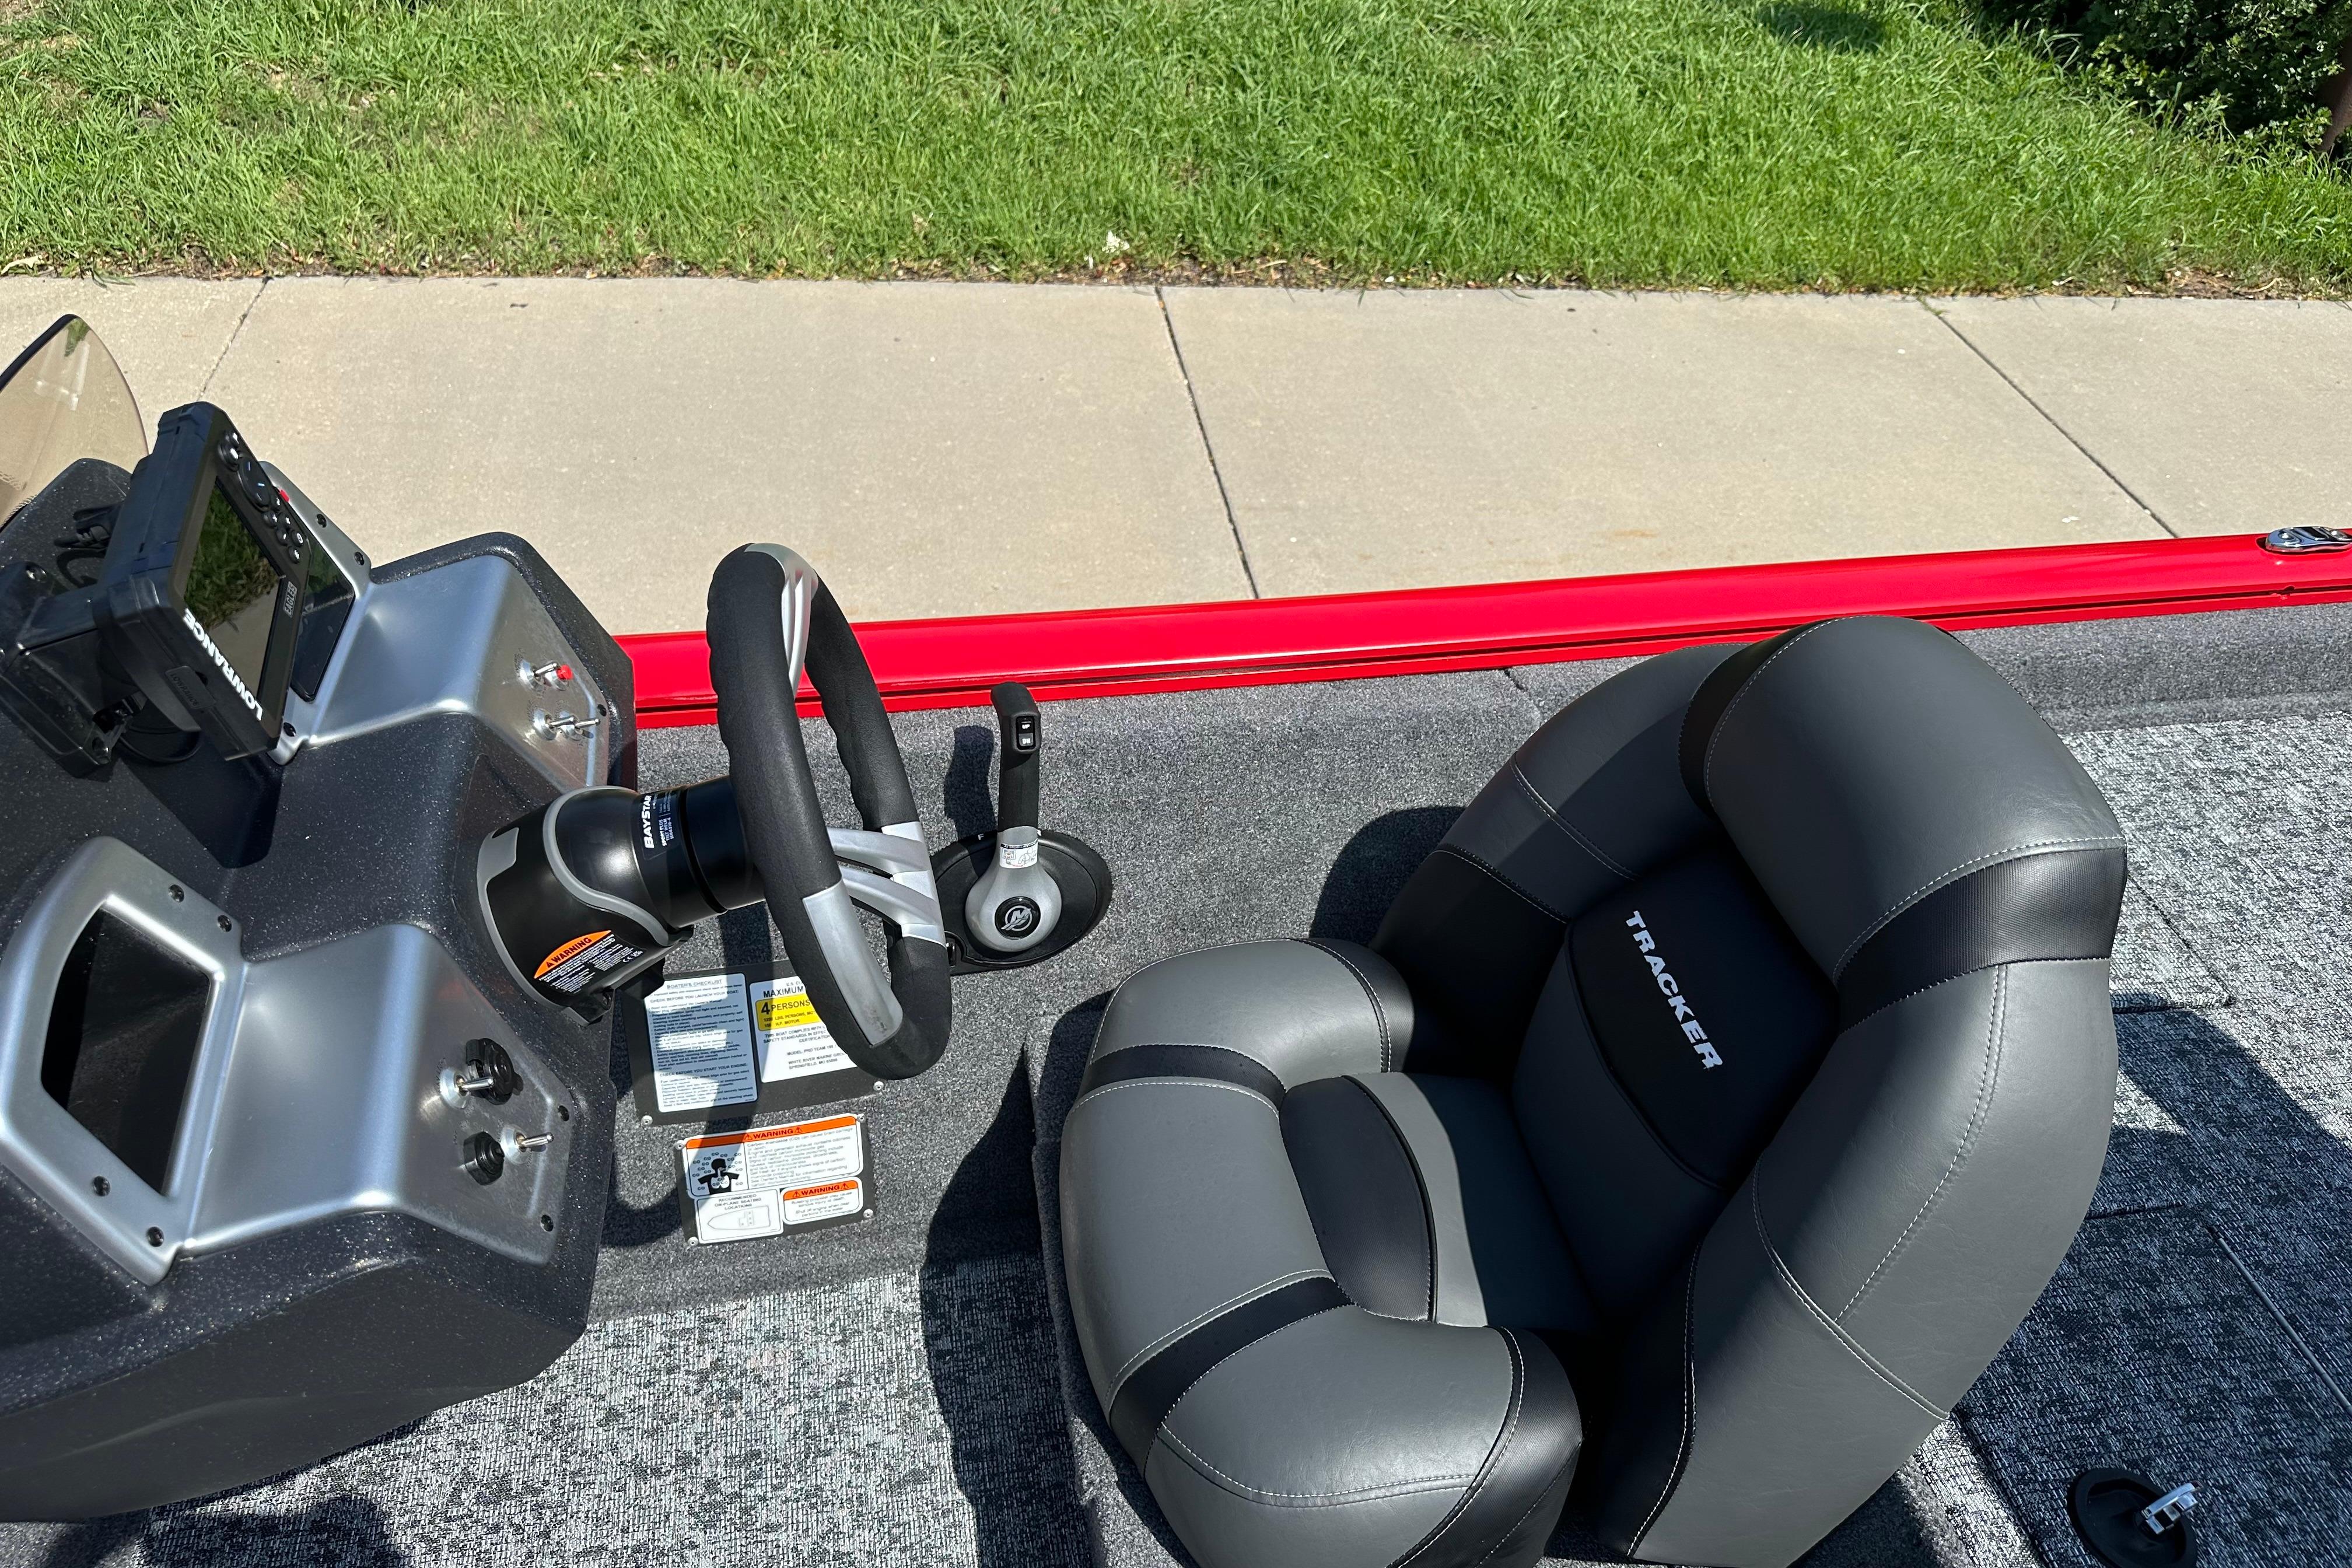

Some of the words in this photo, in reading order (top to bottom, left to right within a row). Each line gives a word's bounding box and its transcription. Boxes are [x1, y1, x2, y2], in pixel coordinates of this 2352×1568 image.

[183, 608, 263, 721] LOWRANCE
[551, 937, 592, 963] WARNING
[763, 985, 804, 998] MAXIMUM
[1626, 910, 1723, 1070] TRACKER
[761, 1002, 770, 1016] 4
[771, 999, 810, 1011] PERSONS
[753, 1128, 793, 1139] WARNING
[801, 1185, 839, 1196] WARNING
